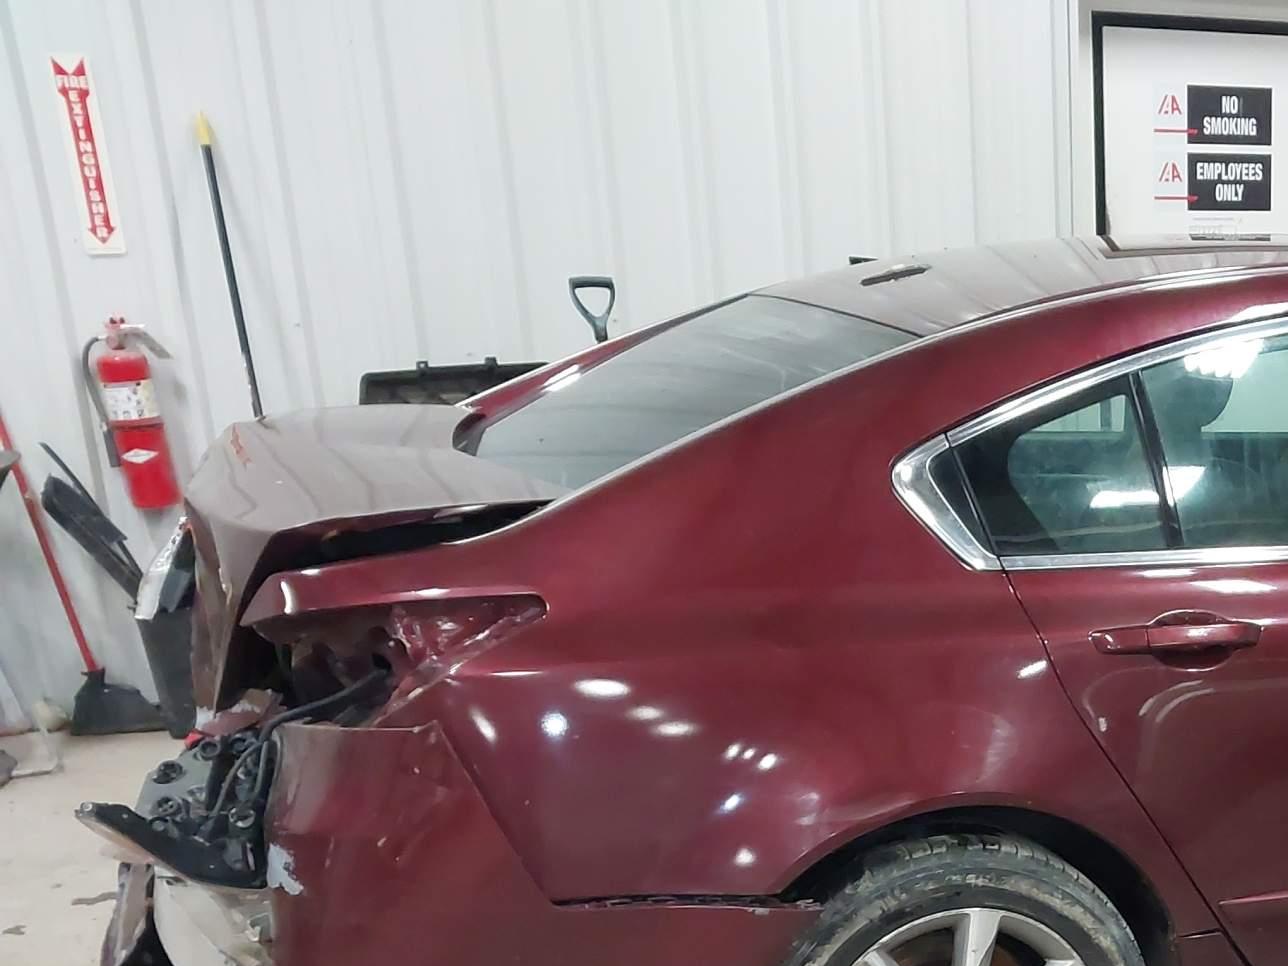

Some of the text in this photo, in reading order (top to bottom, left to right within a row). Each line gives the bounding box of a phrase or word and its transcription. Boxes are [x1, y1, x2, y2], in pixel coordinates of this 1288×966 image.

[1221, 95, 1239, 114] NO
[1203, 116, 1257, 136] SMOKING
[1196, 162, 1264, 181] EMPLOYEES
[1215, 183, 1244, 202] ONLY
